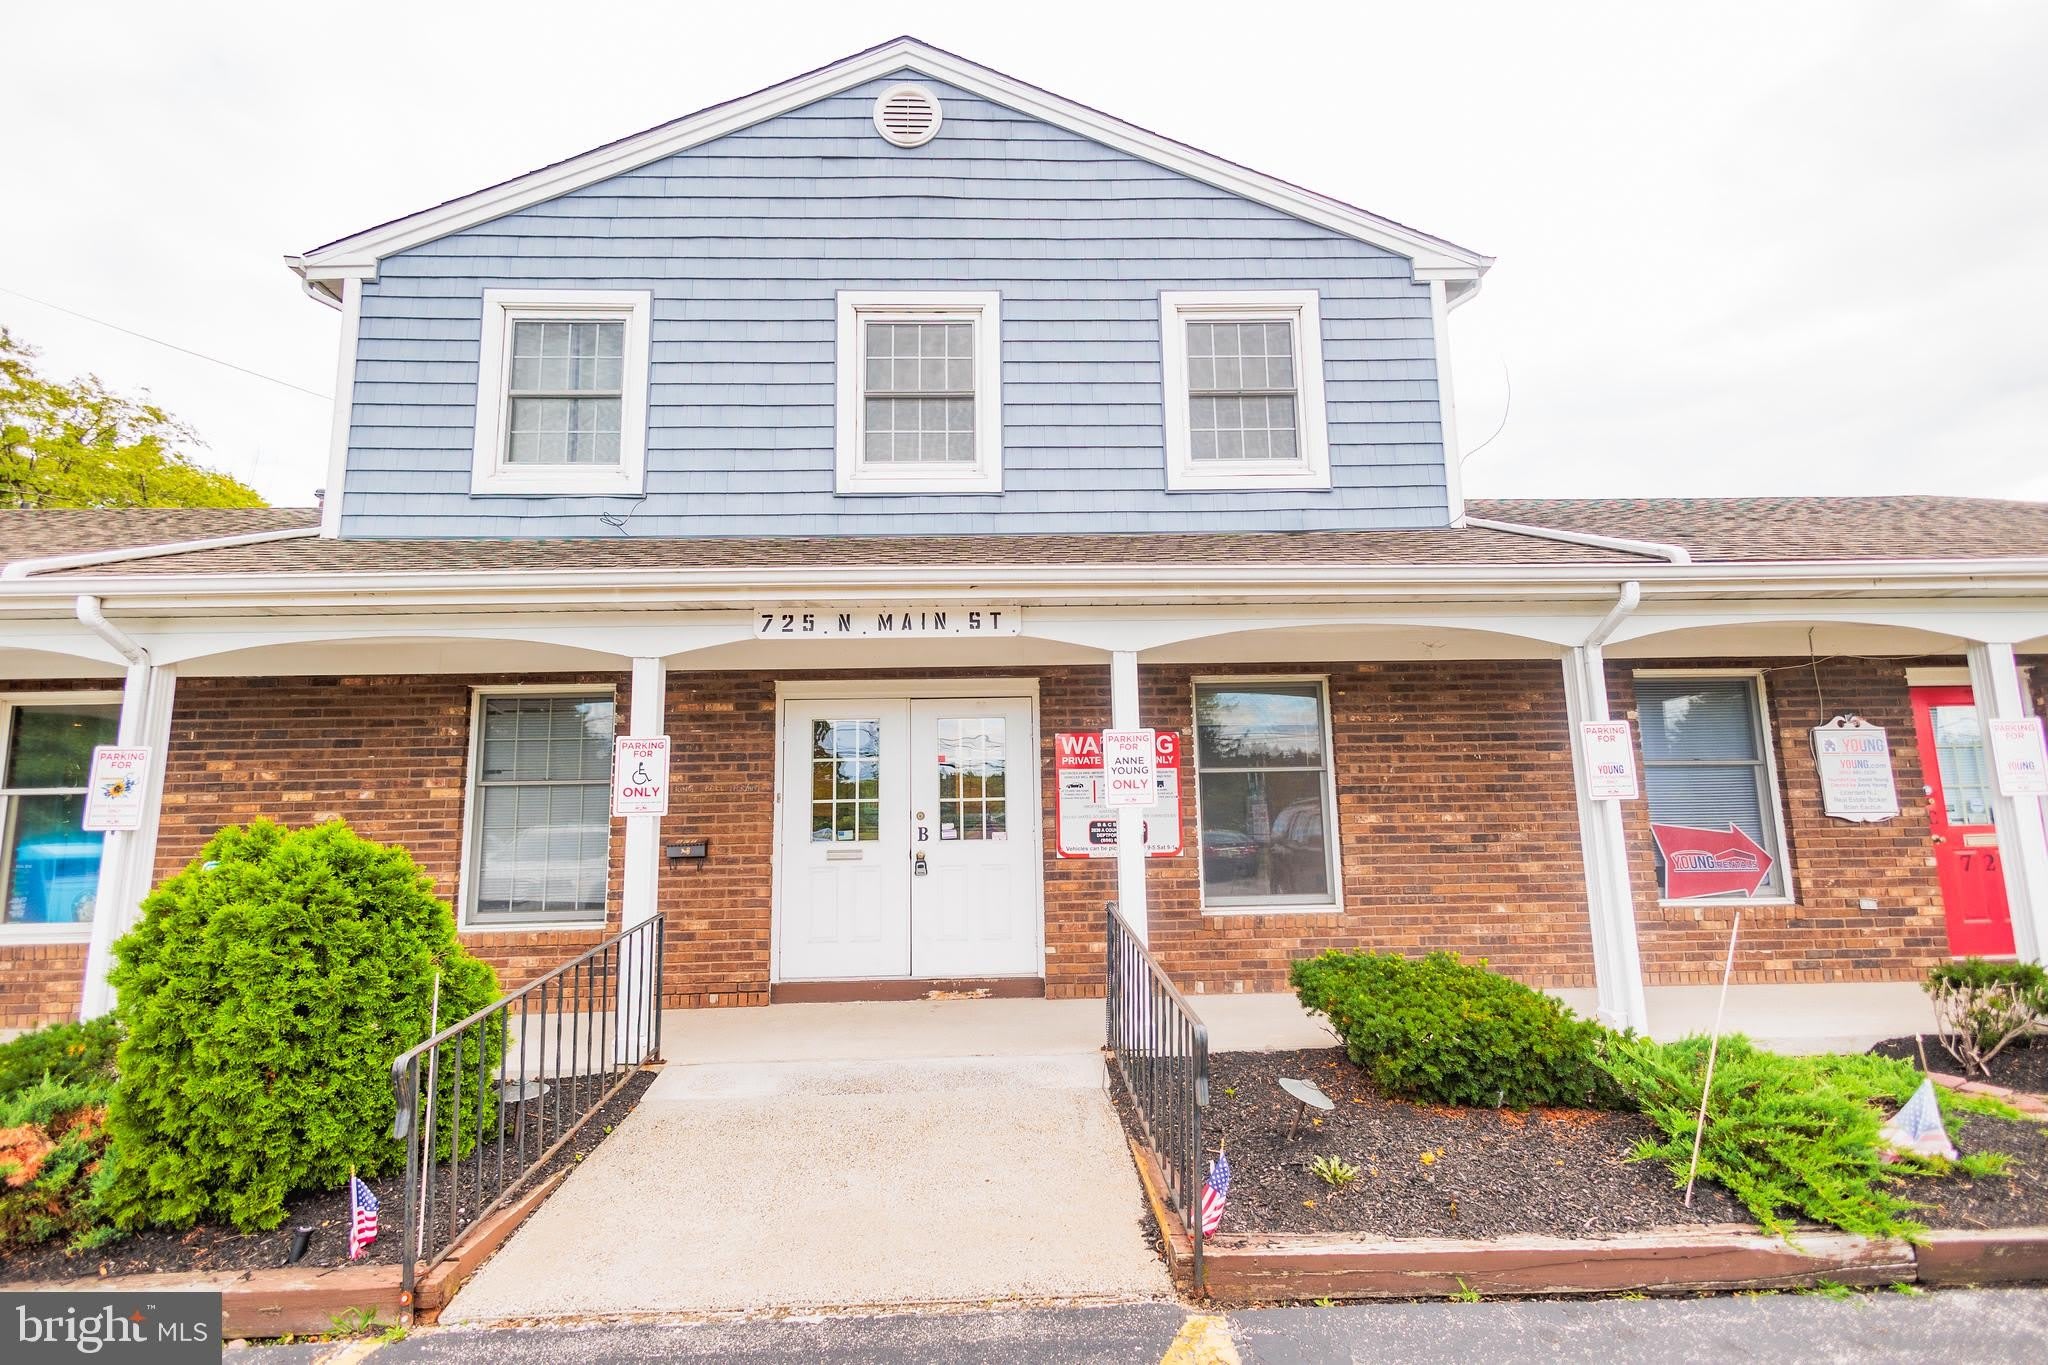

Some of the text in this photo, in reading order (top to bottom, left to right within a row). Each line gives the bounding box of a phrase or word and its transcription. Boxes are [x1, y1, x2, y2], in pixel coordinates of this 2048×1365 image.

[1586, 727, 1625, 735] PARKING
[1108, 735, 1150, 743] PARKING
[1597, 735, 1616, 743] FOR
[622, 741, 665, 750] PARKING
[1119, 743, 1139, 751] FOR
[1843, 738, 1884, 752] YOUNG
[100, 752, 145, 761] PARKING
[633, 750, 654, 758] FOR
[1062, 755, 1174, 765] PRIVATE NLY
[1114, 757, 1145, 765] ANNE
[111, 761, 132, 769] FOR
[2007, 761, 2035, 770] YOUNG
[1111, 766, 1149, 775] YOUNG
[1598, 765, 1625, 775] YOUNG
[1112, 779, 1149, 790] ONLY
[623, 786, 660, 798] ONLY
[917, 826, 929, 842] B
